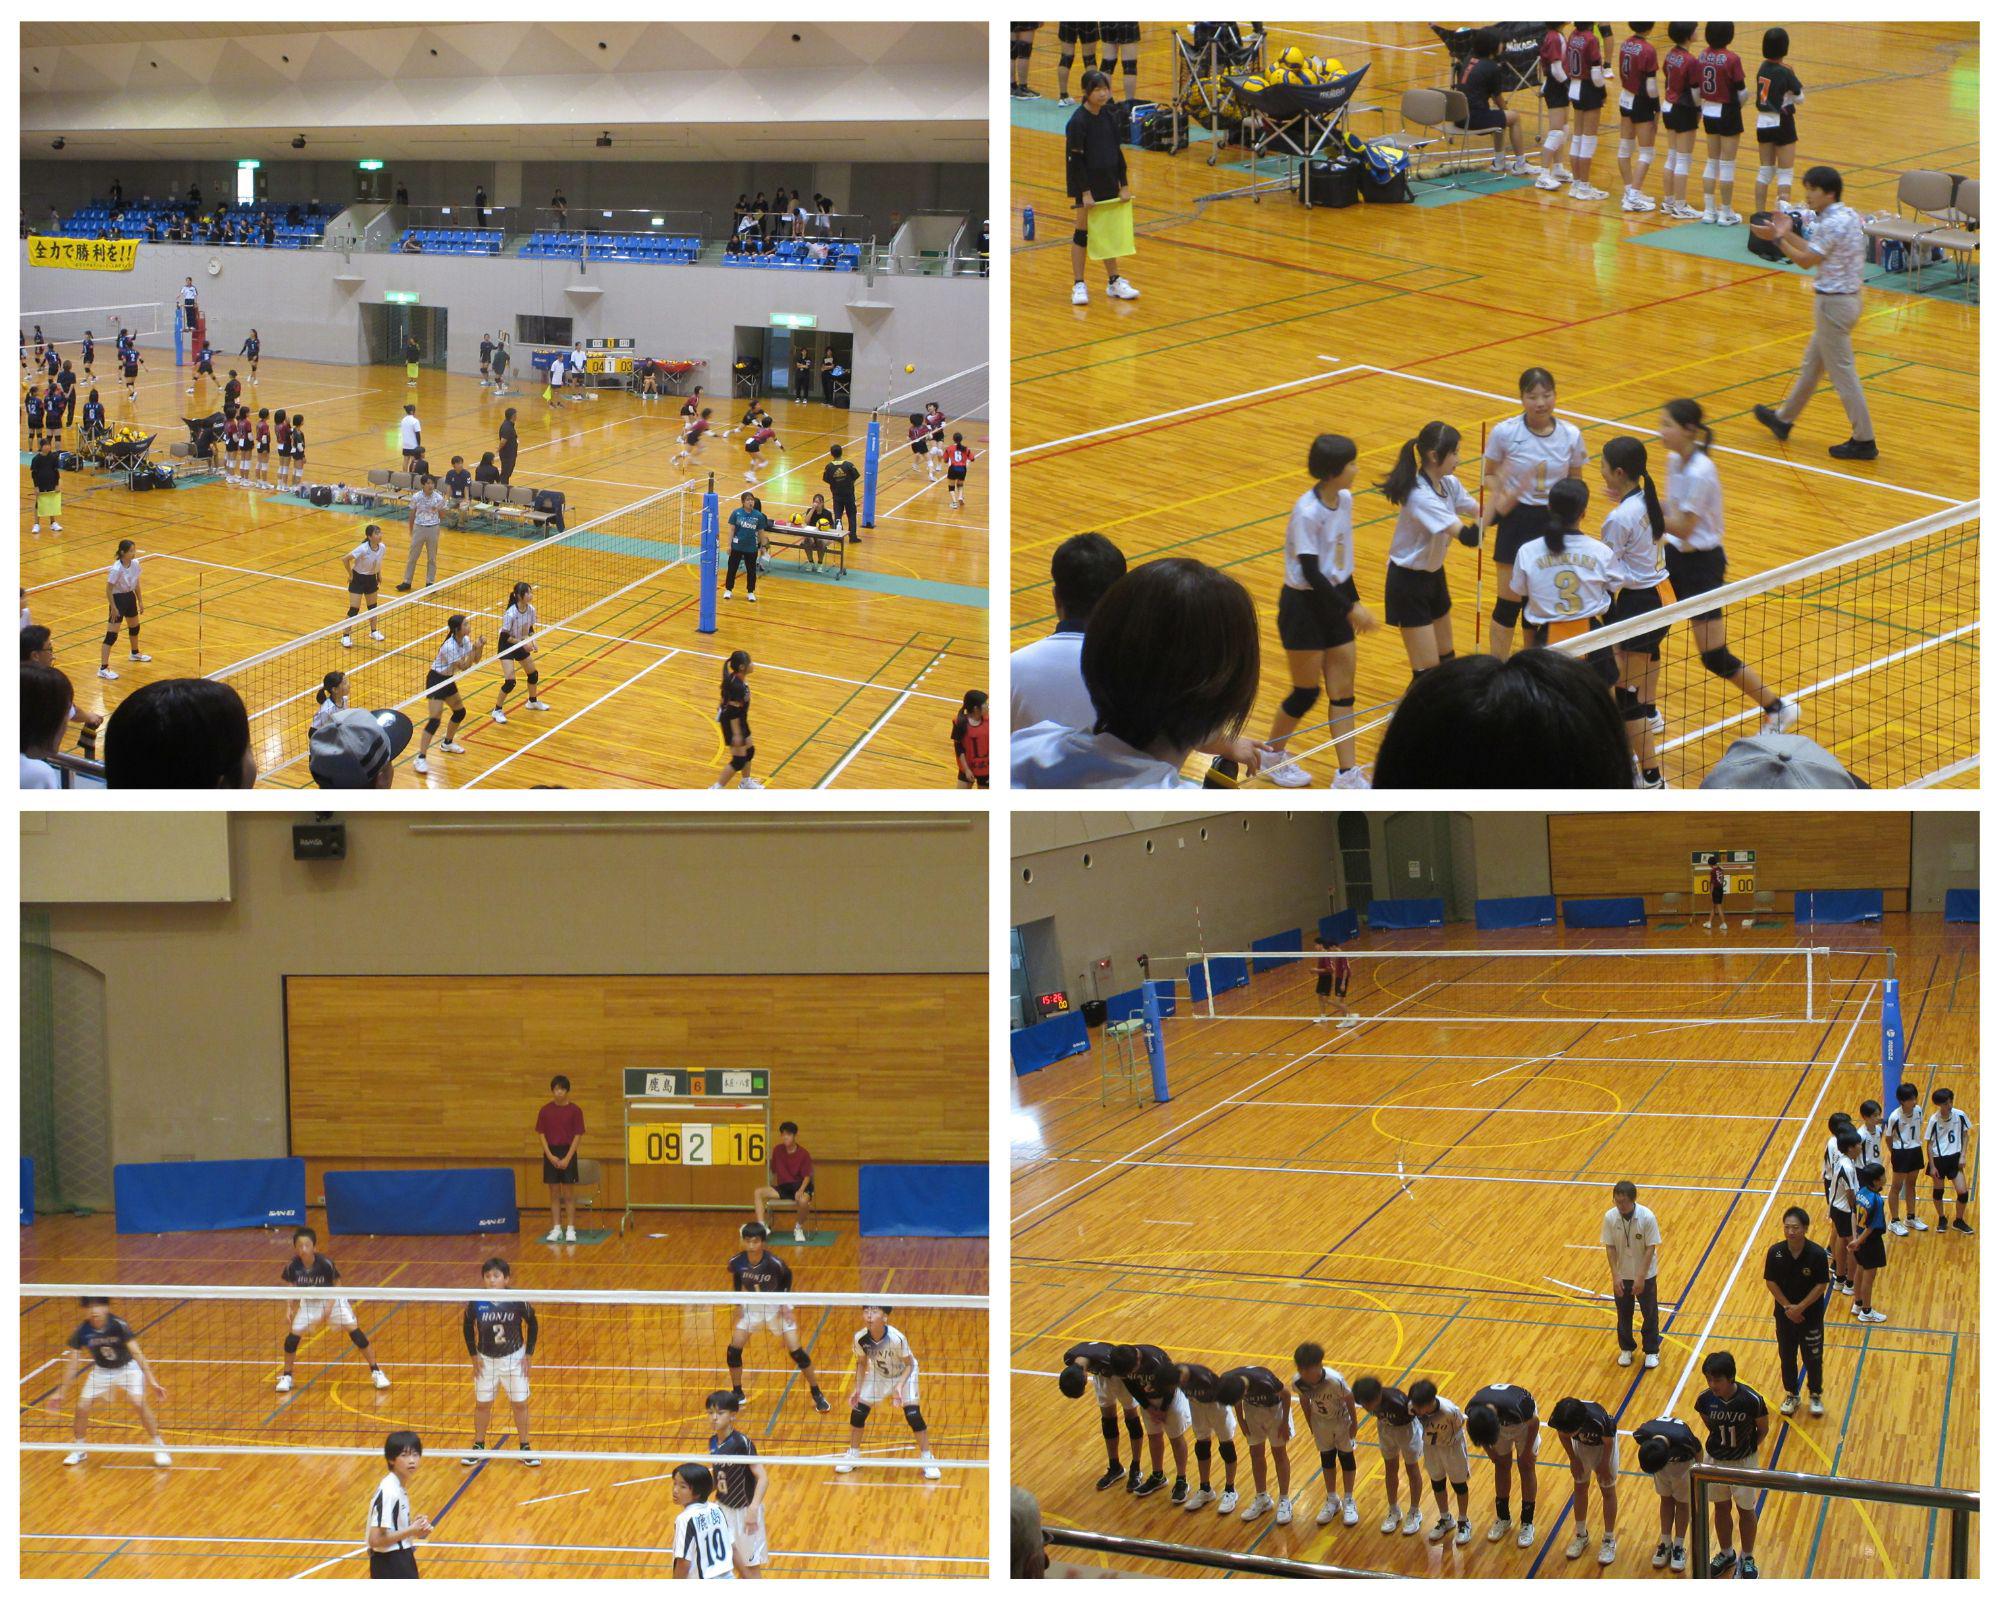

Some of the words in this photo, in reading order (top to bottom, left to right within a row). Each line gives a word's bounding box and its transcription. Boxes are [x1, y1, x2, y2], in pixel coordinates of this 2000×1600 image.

[1505, 39, 1538, 51] MIKASA
[1702, 65, 1716, 94] 3
[1759, 76, 1771, 105] 7
[130, 353, 136, 362] 2
[592, 361, 604, 372] 04
[608, 361, 612, 371] 1
[621, 361, 633, 372] 03
[47, 400, 53, 411] 3
[89, 408, 95, 420] 6
[1554, 569, 1584, 616] 3
[1738, 878, 1753, 892] 00
[1042, 992, 1063, 1005] 15:26
[1058, 1000, 1068, 1010] 00
[649, 1078, 673, 1093] 鹿島
[694, 1081, 702, 1092] 6
[1947, 1130, 1956, 1144] 6
[647, 1132, 680, 1161] 09
[689, 1133, 705, 1162] 2
[733, 1132, 764, 1162] 16
[1872, 1144, 1880, 1159] 8
[481, 1311, 515, 1323] HONJO
[492, 1323, 507, 1345] 2
[876, 1359, 890, 1376] 5
[1710, 1410, 1747, 1423] HONJO
[1426, 1431, 1438, 1446] 7
[1718, 1424, 1737, 1448] 11
[704, 1528, 726, 1567] 10
